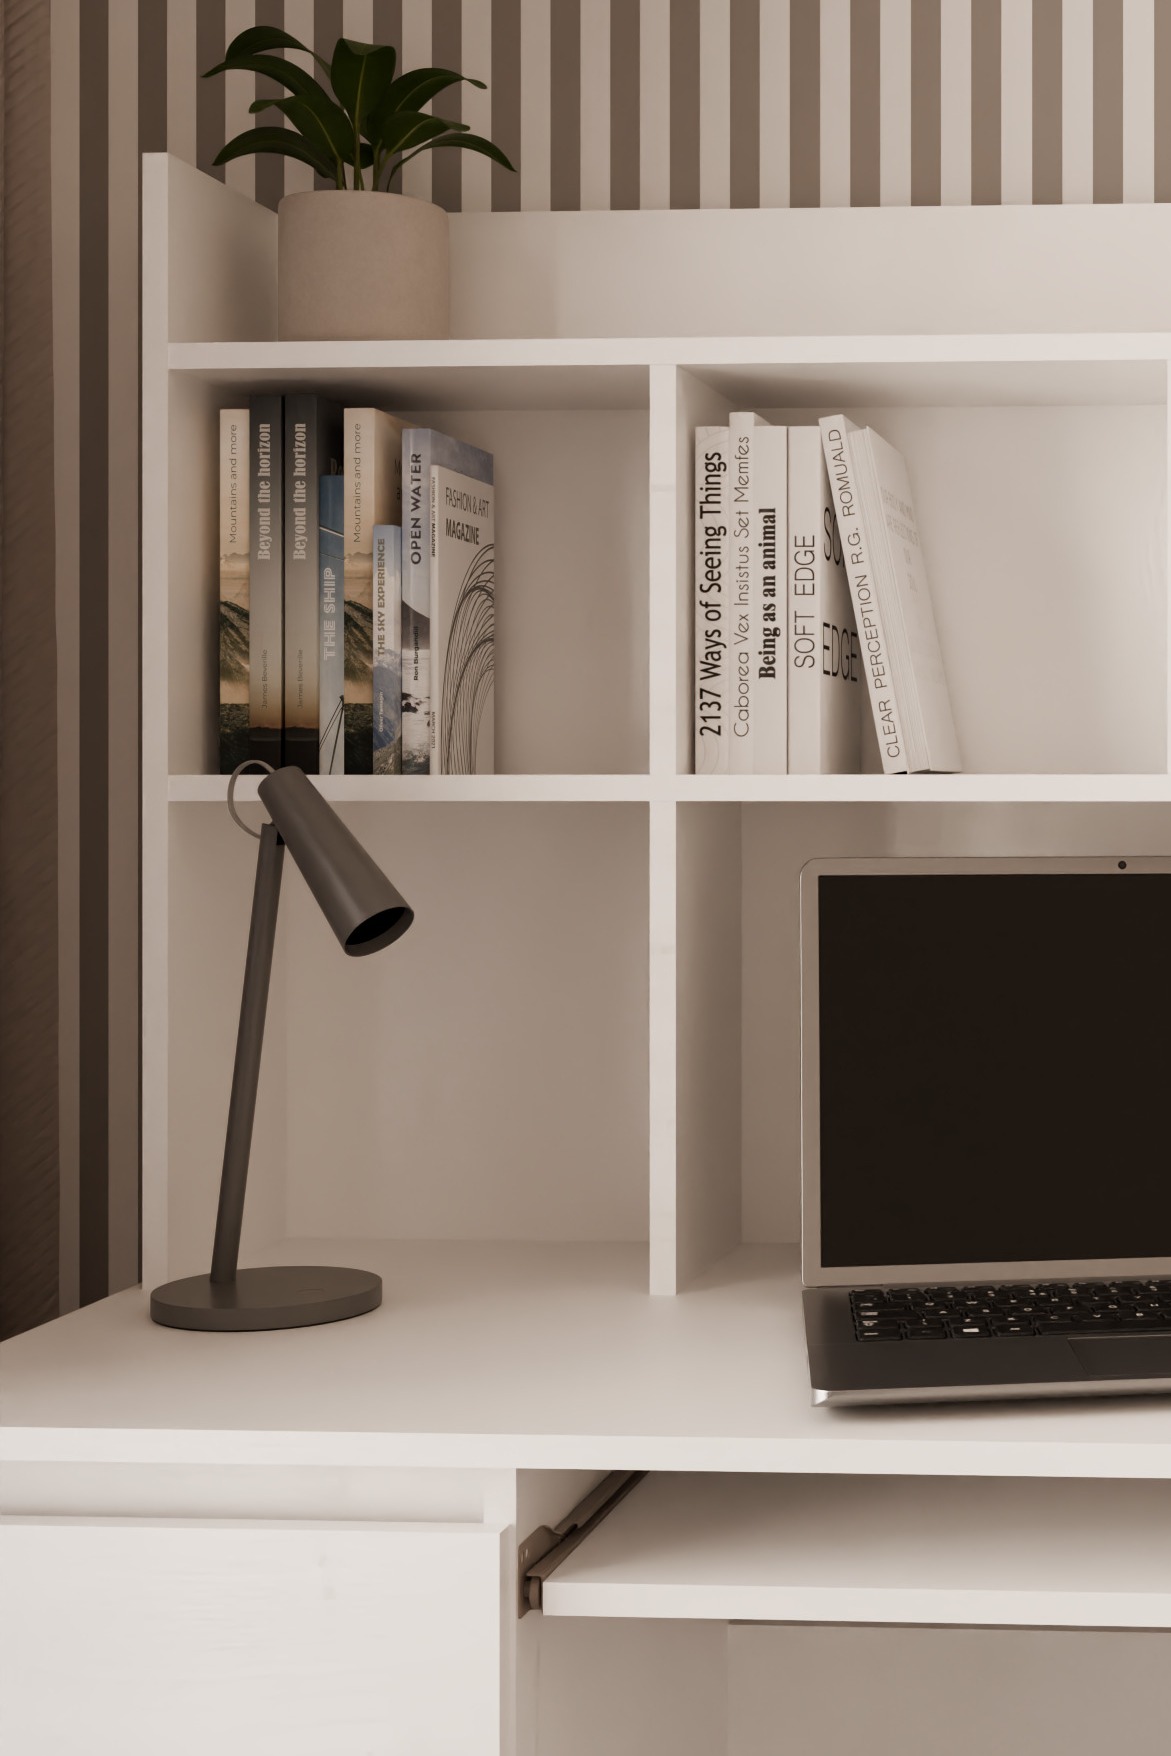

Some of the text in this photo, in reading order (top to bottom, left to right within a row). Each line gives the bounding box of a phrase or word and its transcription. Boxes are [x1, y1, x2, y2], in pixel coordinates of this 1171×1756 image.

[229, 424, 238, 543] Mountains and more
[257, 424, 273, 560] Beyond the horizon
[293, 424, 307, 560] Beyond the horizon
[353, 457, 361, 479] and
[353, 482, 361, 543] Mountains
[410, 453, 421, 565] OPEN WATER
[445, 487, 489, 518] FASHION & ART
[445, 518, 479, 545] MAGAZINE
[734, 436, 749, 737] Caborea Vex Insistus Set Memfes
[324, 567, 336, 661] THE SHIP
[699, 452, 727, 736] 2137 Ways of Seeing Things
[758, 508, 781, 679] Being as an animal
[794, 535, 815, 668] SOFT EDGE
[823, 622, 857, 682] EDGE
[828, 429, 900, 758] CLEAR PERCEPTION R.G. ROMUALD
